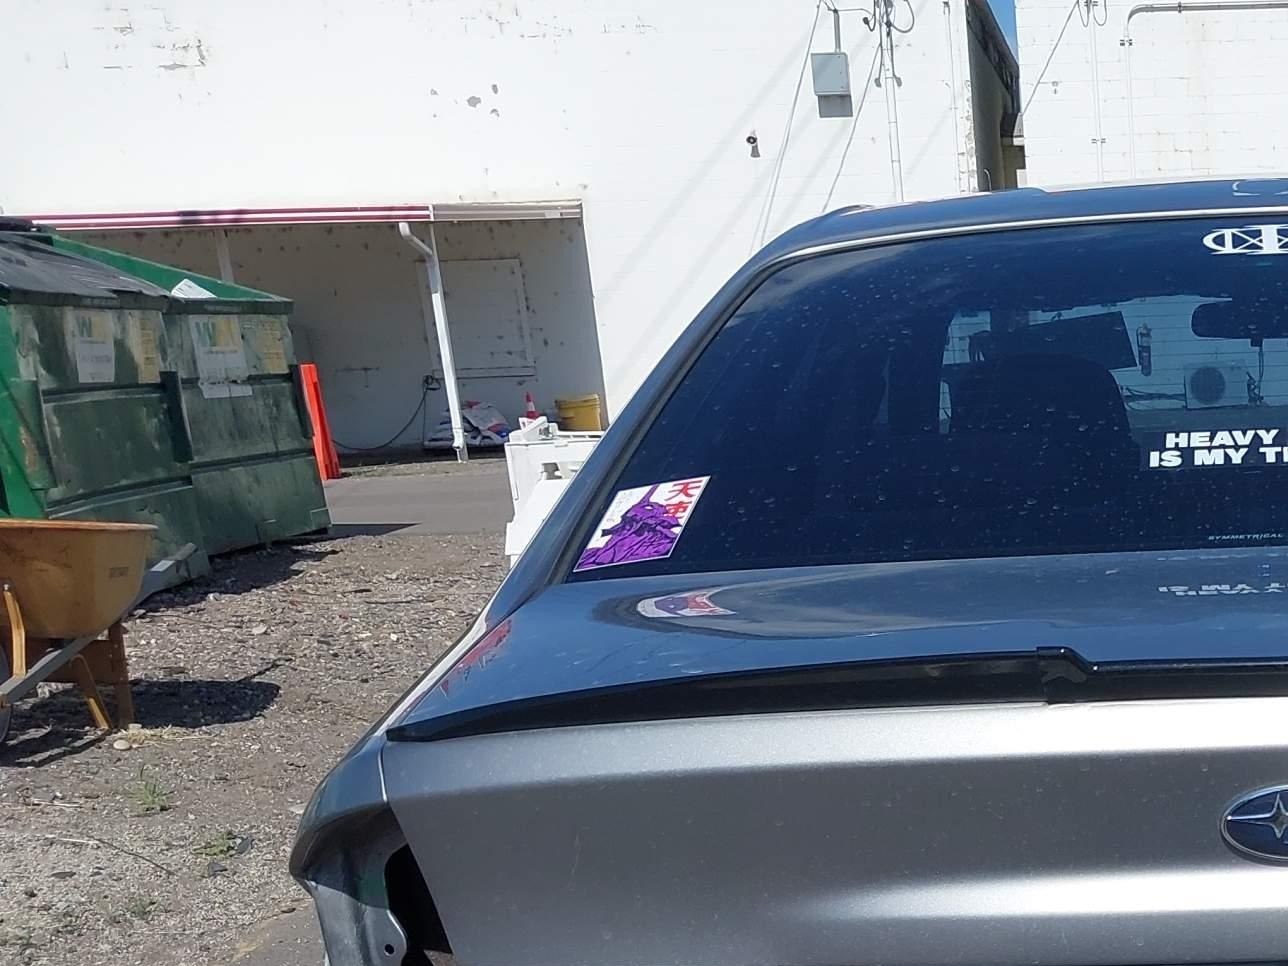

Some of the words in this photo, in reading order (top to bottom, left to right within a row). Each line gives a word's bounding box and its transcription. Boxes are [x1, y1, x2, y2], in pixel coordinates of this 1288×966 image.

[1166, 428, 1279, 448] HEAVY
[1149, 450, 1182, 468] IS
[1194, 448, 1248, 466] MY
[1208, 533, 1283, 541] SYMMETRICAL
